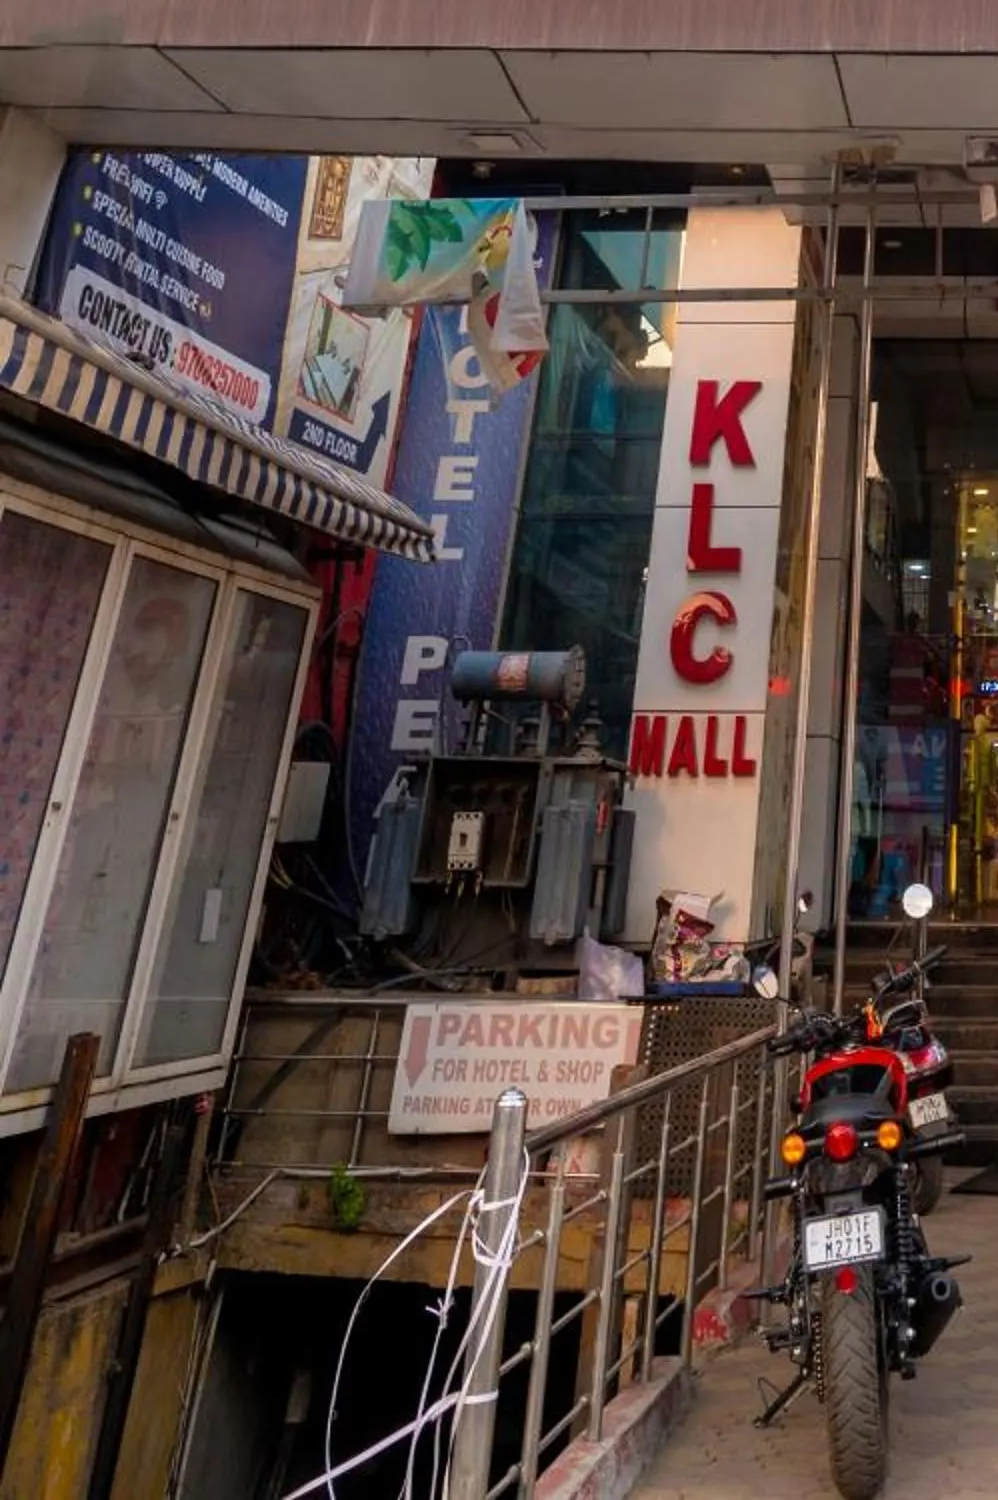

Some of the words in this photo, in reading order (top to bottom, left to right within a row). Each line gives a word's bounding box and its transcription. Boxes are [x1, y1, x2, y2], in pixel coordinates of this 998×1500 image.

[135, 217, 167, 251] MULTI
[201, 260, 226, 291] FOOD
[158, 274, 201, 313] SERVICE
[77, 284, 151, 354] CONTACT
[149, 321, 173, 363] US
[301, 420, 326, 448] 2ND
[324, 430, 358, 464] FLOOR
[432, 303, 492, 561] OTEL
[628, 714, 758, 778] MALL
[436, 1012, 622, 1050] PARKING
[431, 1058, 468, 1083] FOR
[472, 1058, 531, 1084] HOTEL
[536, 1059, 550, 1083] &
[555, 1058, 606, 1083] SHOP
[402, 1096, 471, 1117] PARKING
[824, 1214, 872, 1240] JH01F
[824, 1233, 873, 1260] M2715
